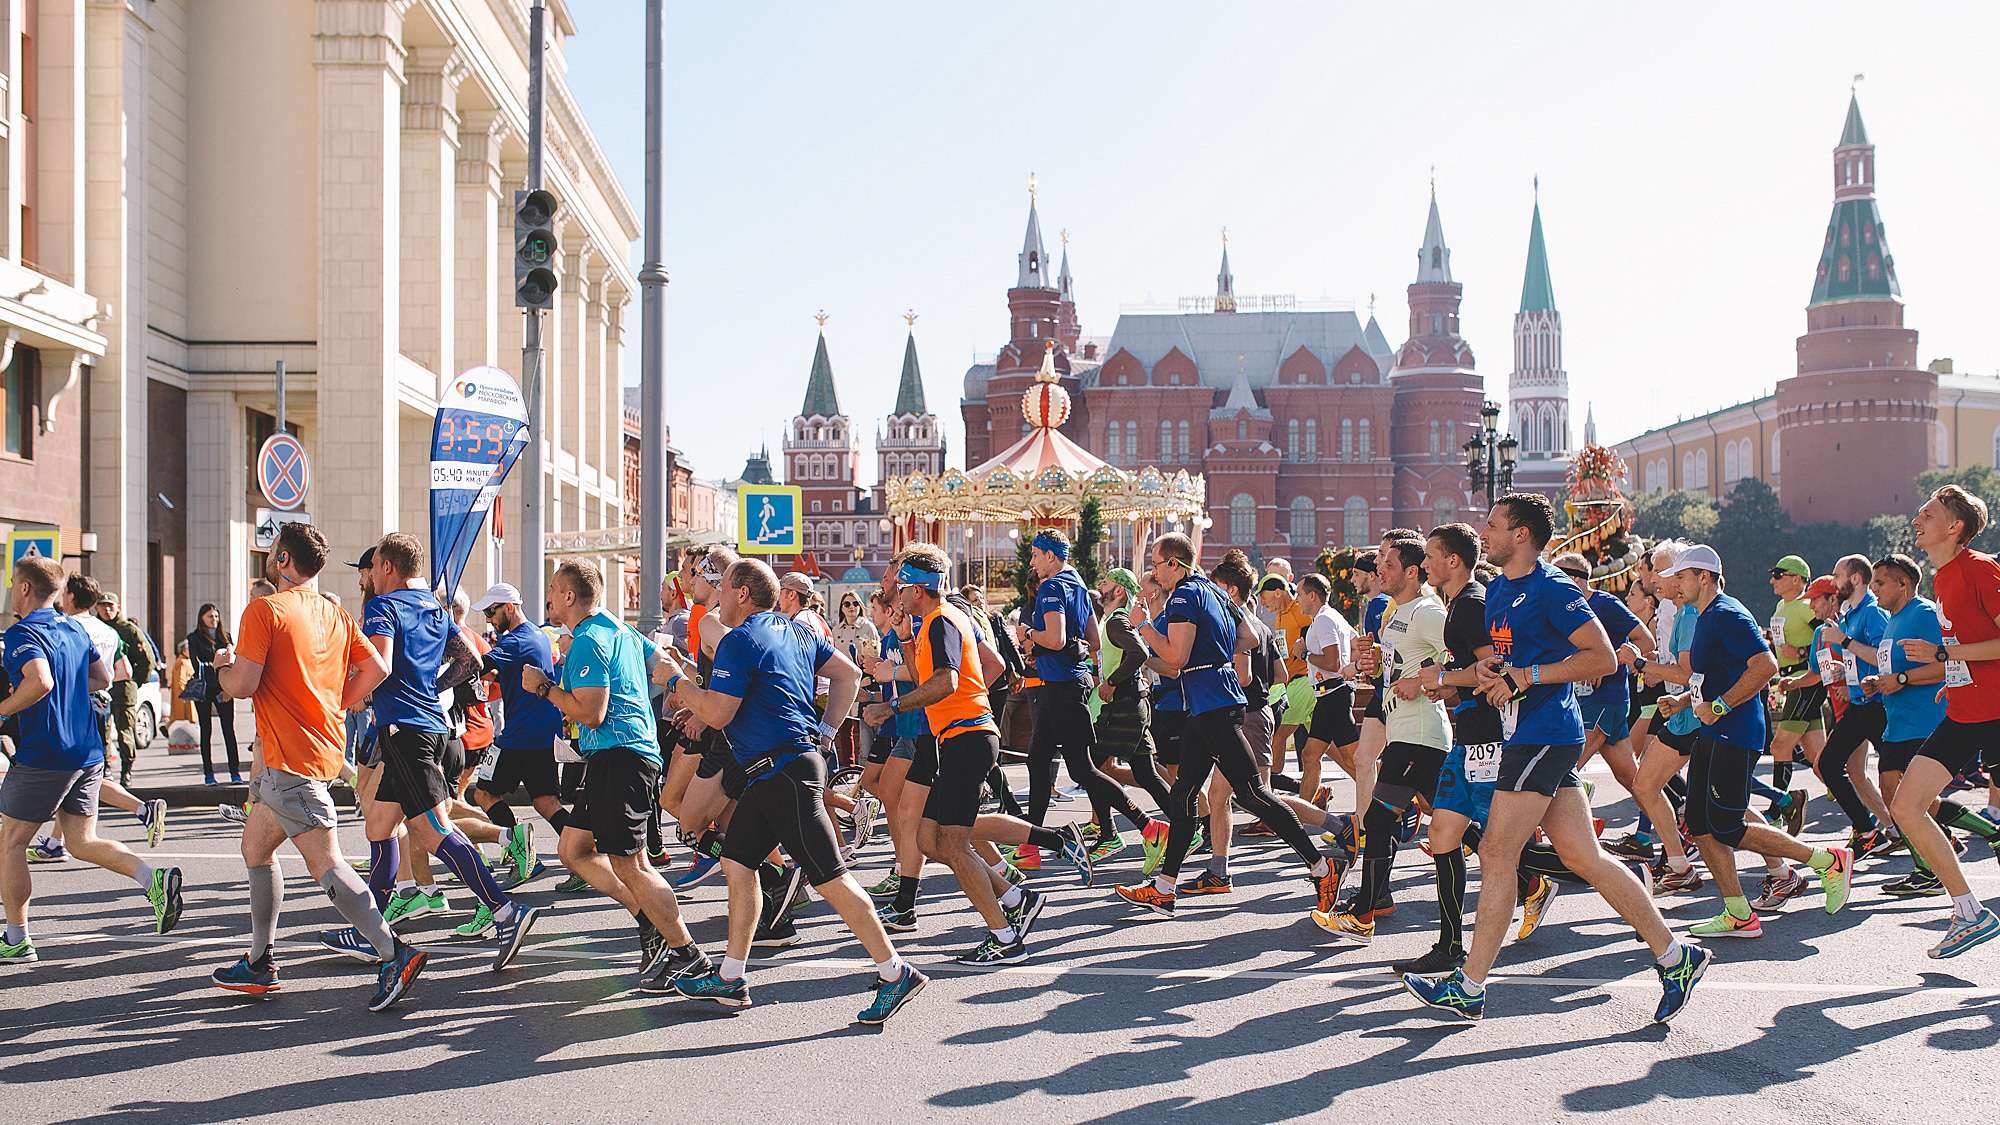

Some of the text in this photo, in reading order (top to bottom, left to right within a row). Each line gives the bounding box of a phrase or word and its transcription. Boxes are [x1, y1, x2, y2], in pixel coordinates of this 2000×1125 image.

[442, 418, 504, 455] 3:59
[434, 468, 462, 482] 05:40
[1470, 770, 1476, 781] F
